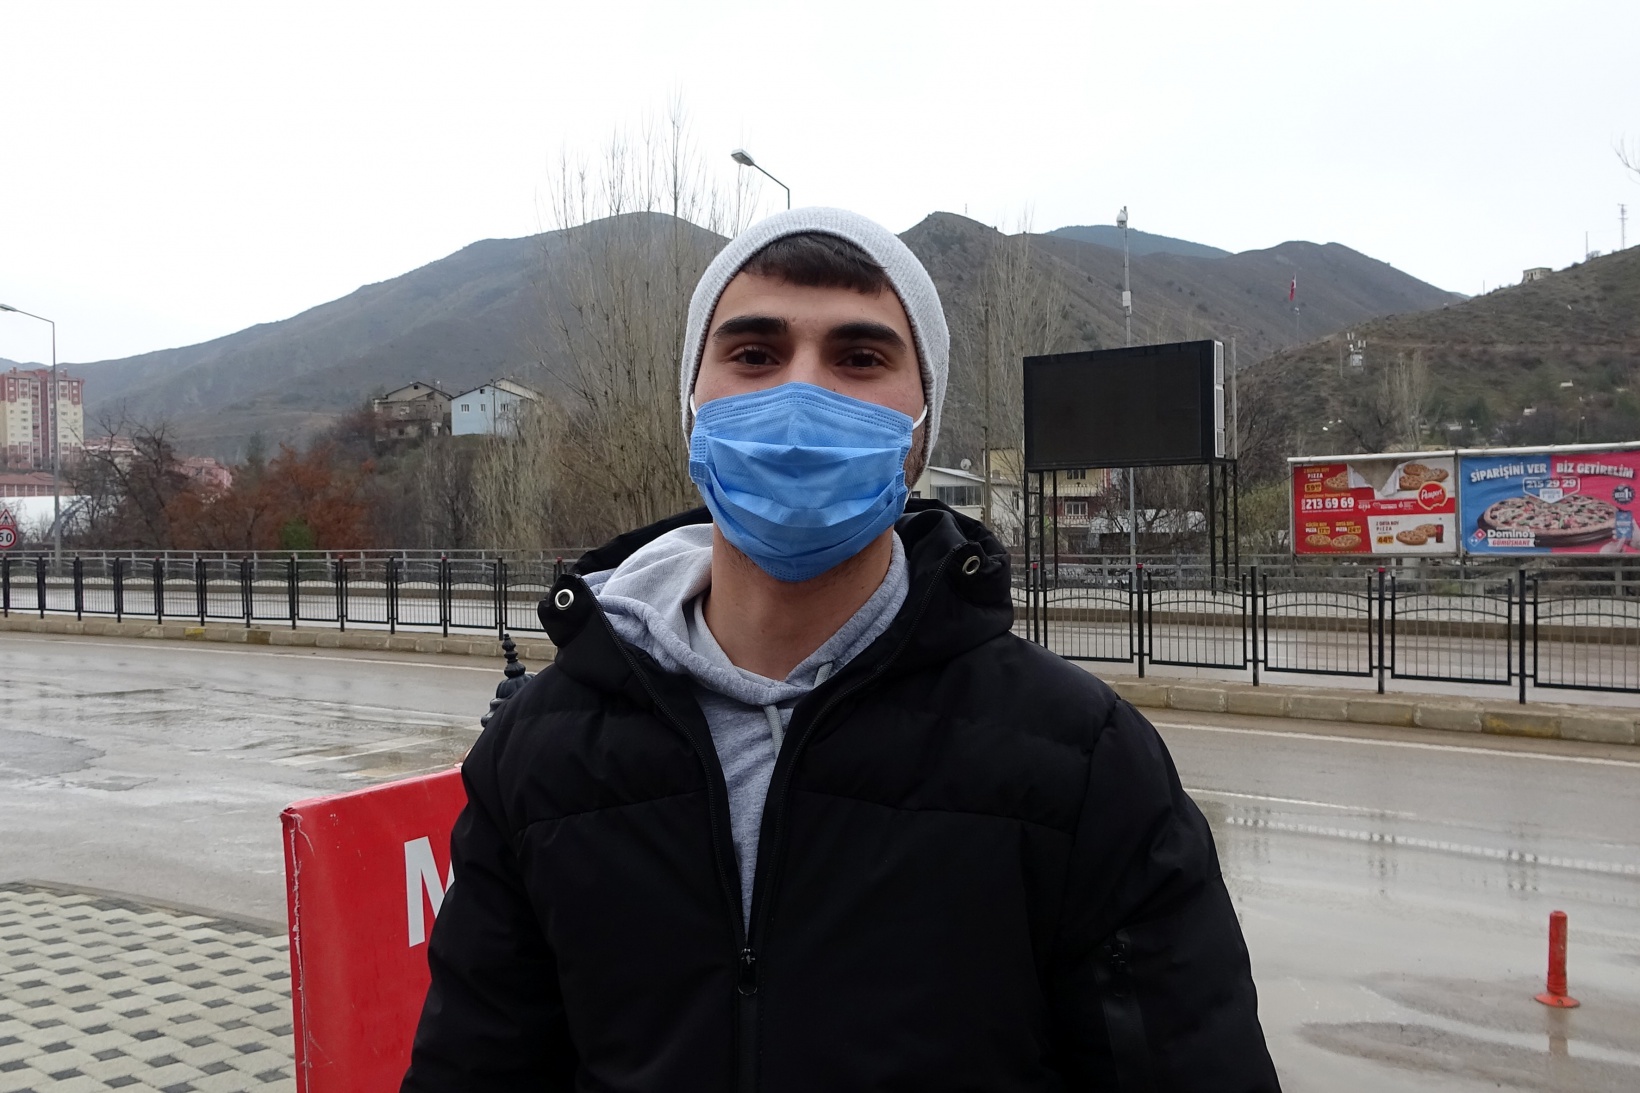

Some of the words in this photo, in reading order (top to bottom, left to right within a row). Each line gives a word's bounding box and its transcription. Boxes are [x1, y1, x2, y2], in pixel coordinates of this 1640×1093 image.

[1471, 462, 1524, 483] SİPARİŞİNİ
[1526, 463, 1547, 474] VER
[1556, 460, 1574, 473] BİZ
[1577, 461, 1634, 479] GETİRELİM
[1545, 479, 1560, 488] 29
[1562, 479, 1577, 488] 29
[1306, 499, 1323, 510] 213
[1325, 498, 1339, 509] 69
[1340, 497, 1355, 508] 69
[0, 532, 12, 543] 50
[1487, 529, 1535, 538] Domino's
